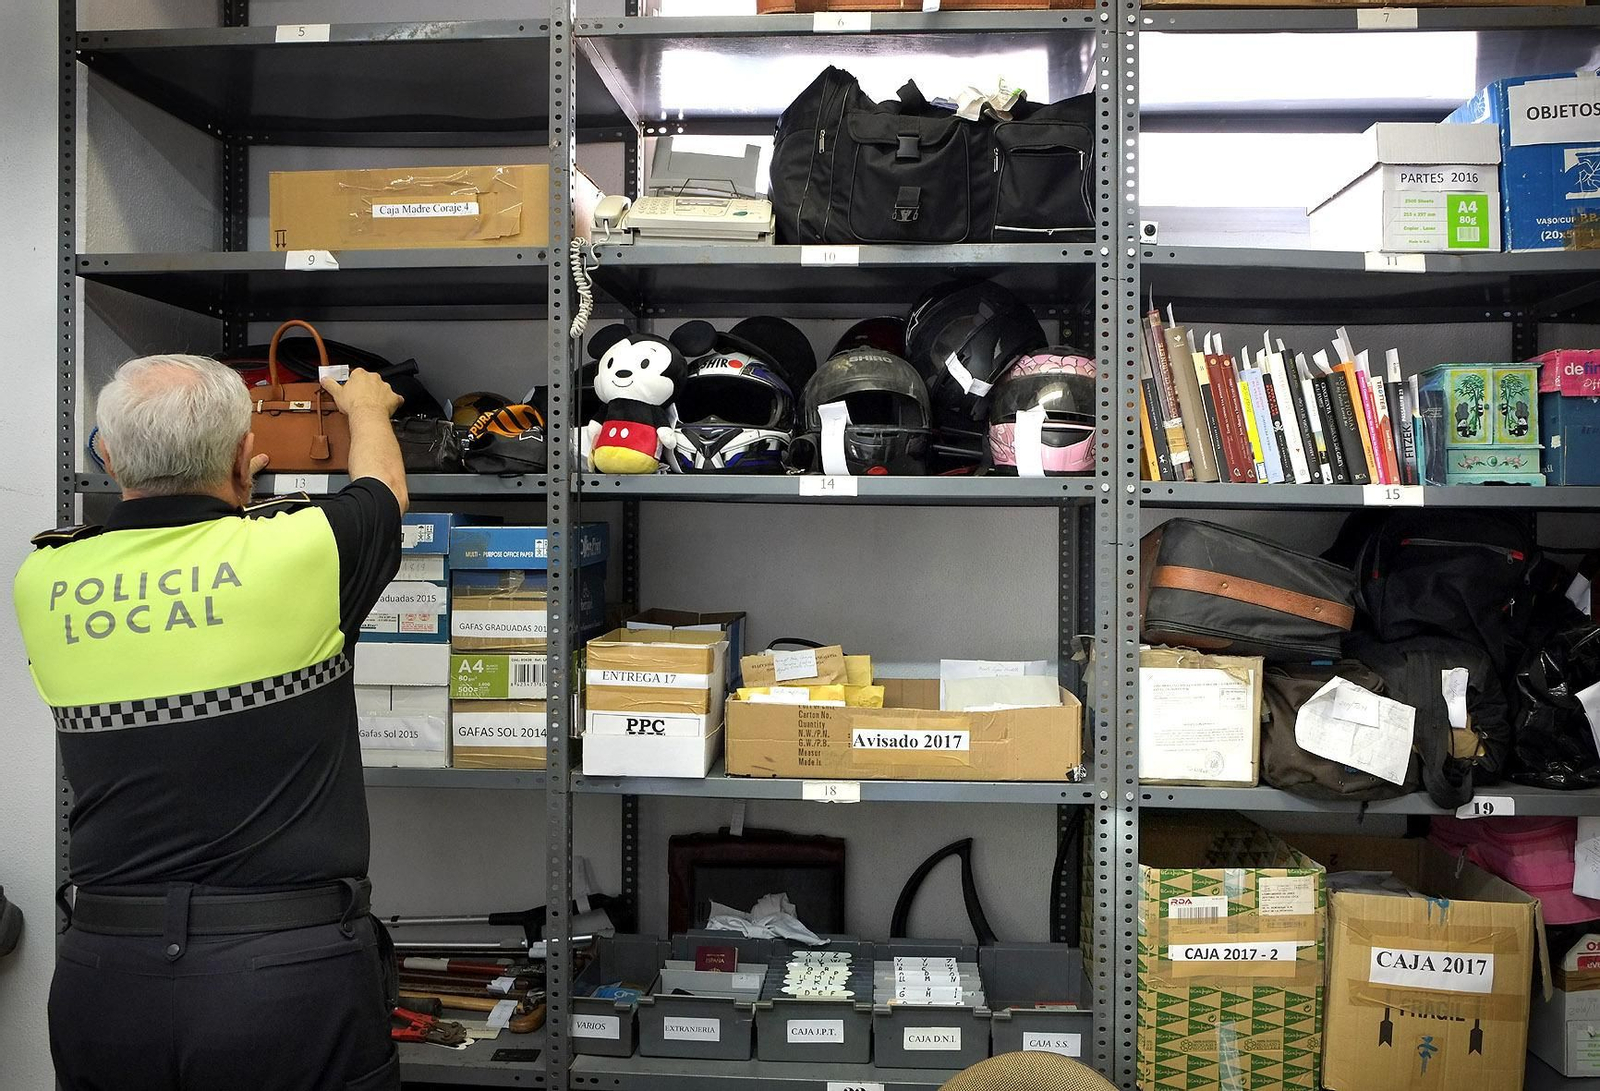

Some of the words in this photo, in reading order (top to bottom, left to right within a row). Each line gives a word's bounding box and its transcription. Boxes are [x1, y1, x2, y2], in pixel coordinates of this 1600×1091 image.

[837, 17, 845, 27] 6
[1383, 13, 1390, 23] 7
[298, 26, 306, 37] 5
[1527, 102, 1600, 120] OBJETOS
[1401, 173, 1444, 183] PARTES
[1451, 172, 1479, 183] 2016
[380, 206, 400, 216] Caja
[402, 204, 430, 214] Madre
[433, 203, 462, 214] Coraje
[463, 203, 469, 211] 4
[1458, 201, 1478, 213] A4
[1459, 216, 1477, 225] 80g
[308, 254, 315, 265] 9
[823, 252, 835, 261] 10
[294, 478, 306, 489] 13
[821, 478, 835, 489] 14
[1385, 489, 1401, 500] 15
[50, 562, 242, 611] POLICIA
[379, 594, 414, 603] aduadas
[417, 594, 436, 603] 2015
[65, 596, 223, 645] LOCAL
[459, 622, 483, 631] GAFAS
[485, 623, 532, 632] GRADUADAS
[458, 659, 484, 673] A4
[602, 671, 660, 683] ENTREGA
[665, 674, 676, 683] 17
[798, 710, 819, 718] Carton
[820, 711, 832, 719] No.
[626, 718, 665, 732] PPC
[798, 720, 825, 729] Quantity
[359, 730, 382, 738] Gafas
[384, 730, 396, 738] Sol
[398, 730, 418, 738] 2015
[459, 727, 494, 737] GAFAS
[497, 728, 518, 737] SOL
[521, 728, 547, 737] 2014
[853, 734, 918, 749] Avisado
[924, 735, 962, 749] 2017
[824, 785, 837, 796] 18
[1474, 802, 1494, 815] 19
[1184, 947, 1220, 960] CAJA
[1223, 948, 1257, 960] 2017
[1269, 948, 1278, 960] 2
[1376, 951, 1435, 971] CAJA
[1442, 957, 1487, 975] 2017
[577, 1021, 606, 1031] VARIOS
[664, 1025, 715, 1033] EXTRANJERIA
[791, 1028, 814, 1036] CAJA
[908, 1035, 931, 1043] CAJA
[1029, 1040, 1051, 1048] CAJA
